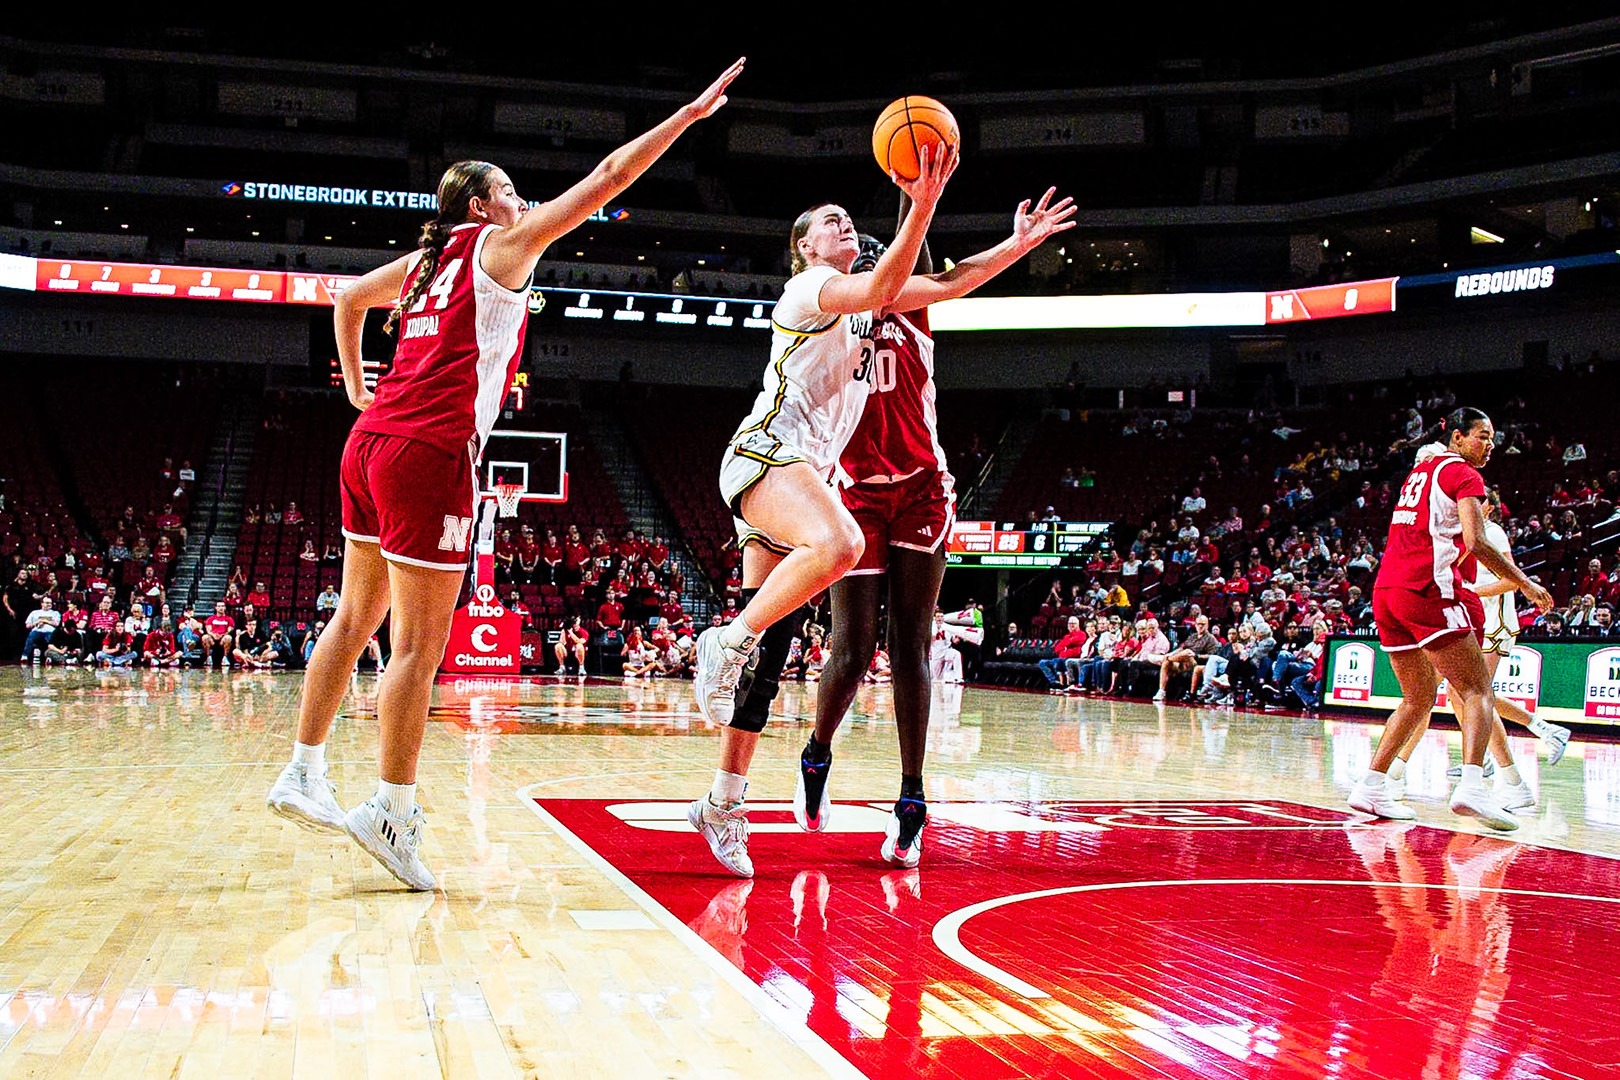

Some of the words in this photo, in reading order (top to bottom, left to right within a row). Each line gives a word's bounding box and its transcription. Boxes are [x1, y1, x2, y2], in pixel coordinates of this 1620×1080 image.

[243, 182, 367, 205] STONEBROOK
[372, 190, 439, 210] EXTERI
[293, 277, 318, 301] N
[407, 258, 463, 313] 4
[1455, 266, 1554, 298] REBOUNDS
[1271, 294, 1294, 319] N
[1398, 471, 1428, 508] 33
[438, 514, 472, 552] N
[468, 601, 505, 618] fnbo
[1442, 605, 1469, 630] N
[455, 653, 513, 667] Channel
[1590, 685, 1620, 698] BEC
